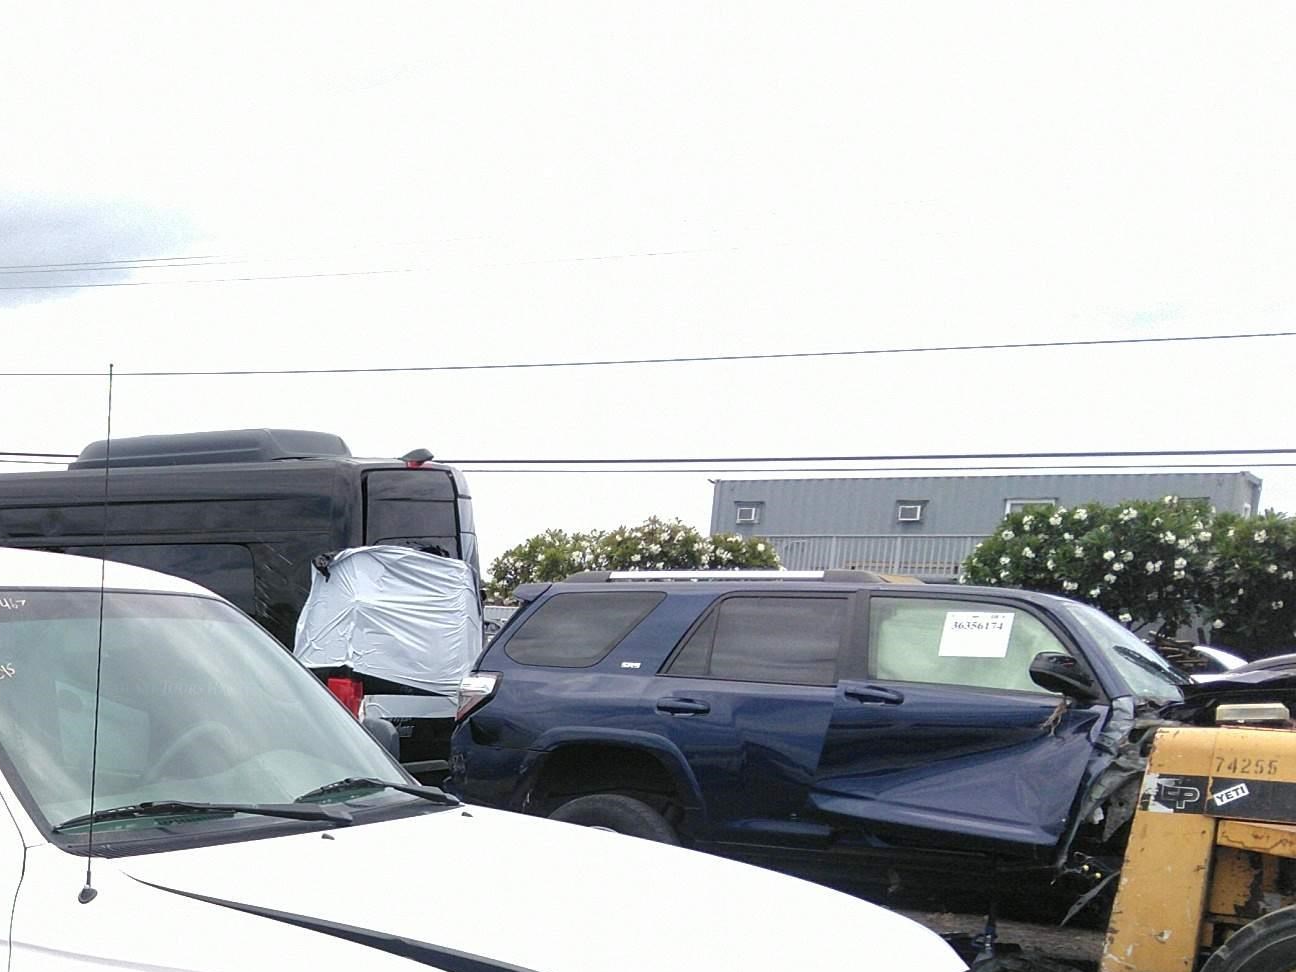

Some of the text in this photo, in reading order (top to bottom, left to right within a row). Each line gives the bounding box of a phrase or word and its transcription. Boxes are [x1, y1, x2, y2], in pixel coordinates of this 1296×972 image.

[951, 621, 1004, 631] 36356174
[1215, 755, 1279, 776] 74255
[1215, 785, 1247, 804] YETI
